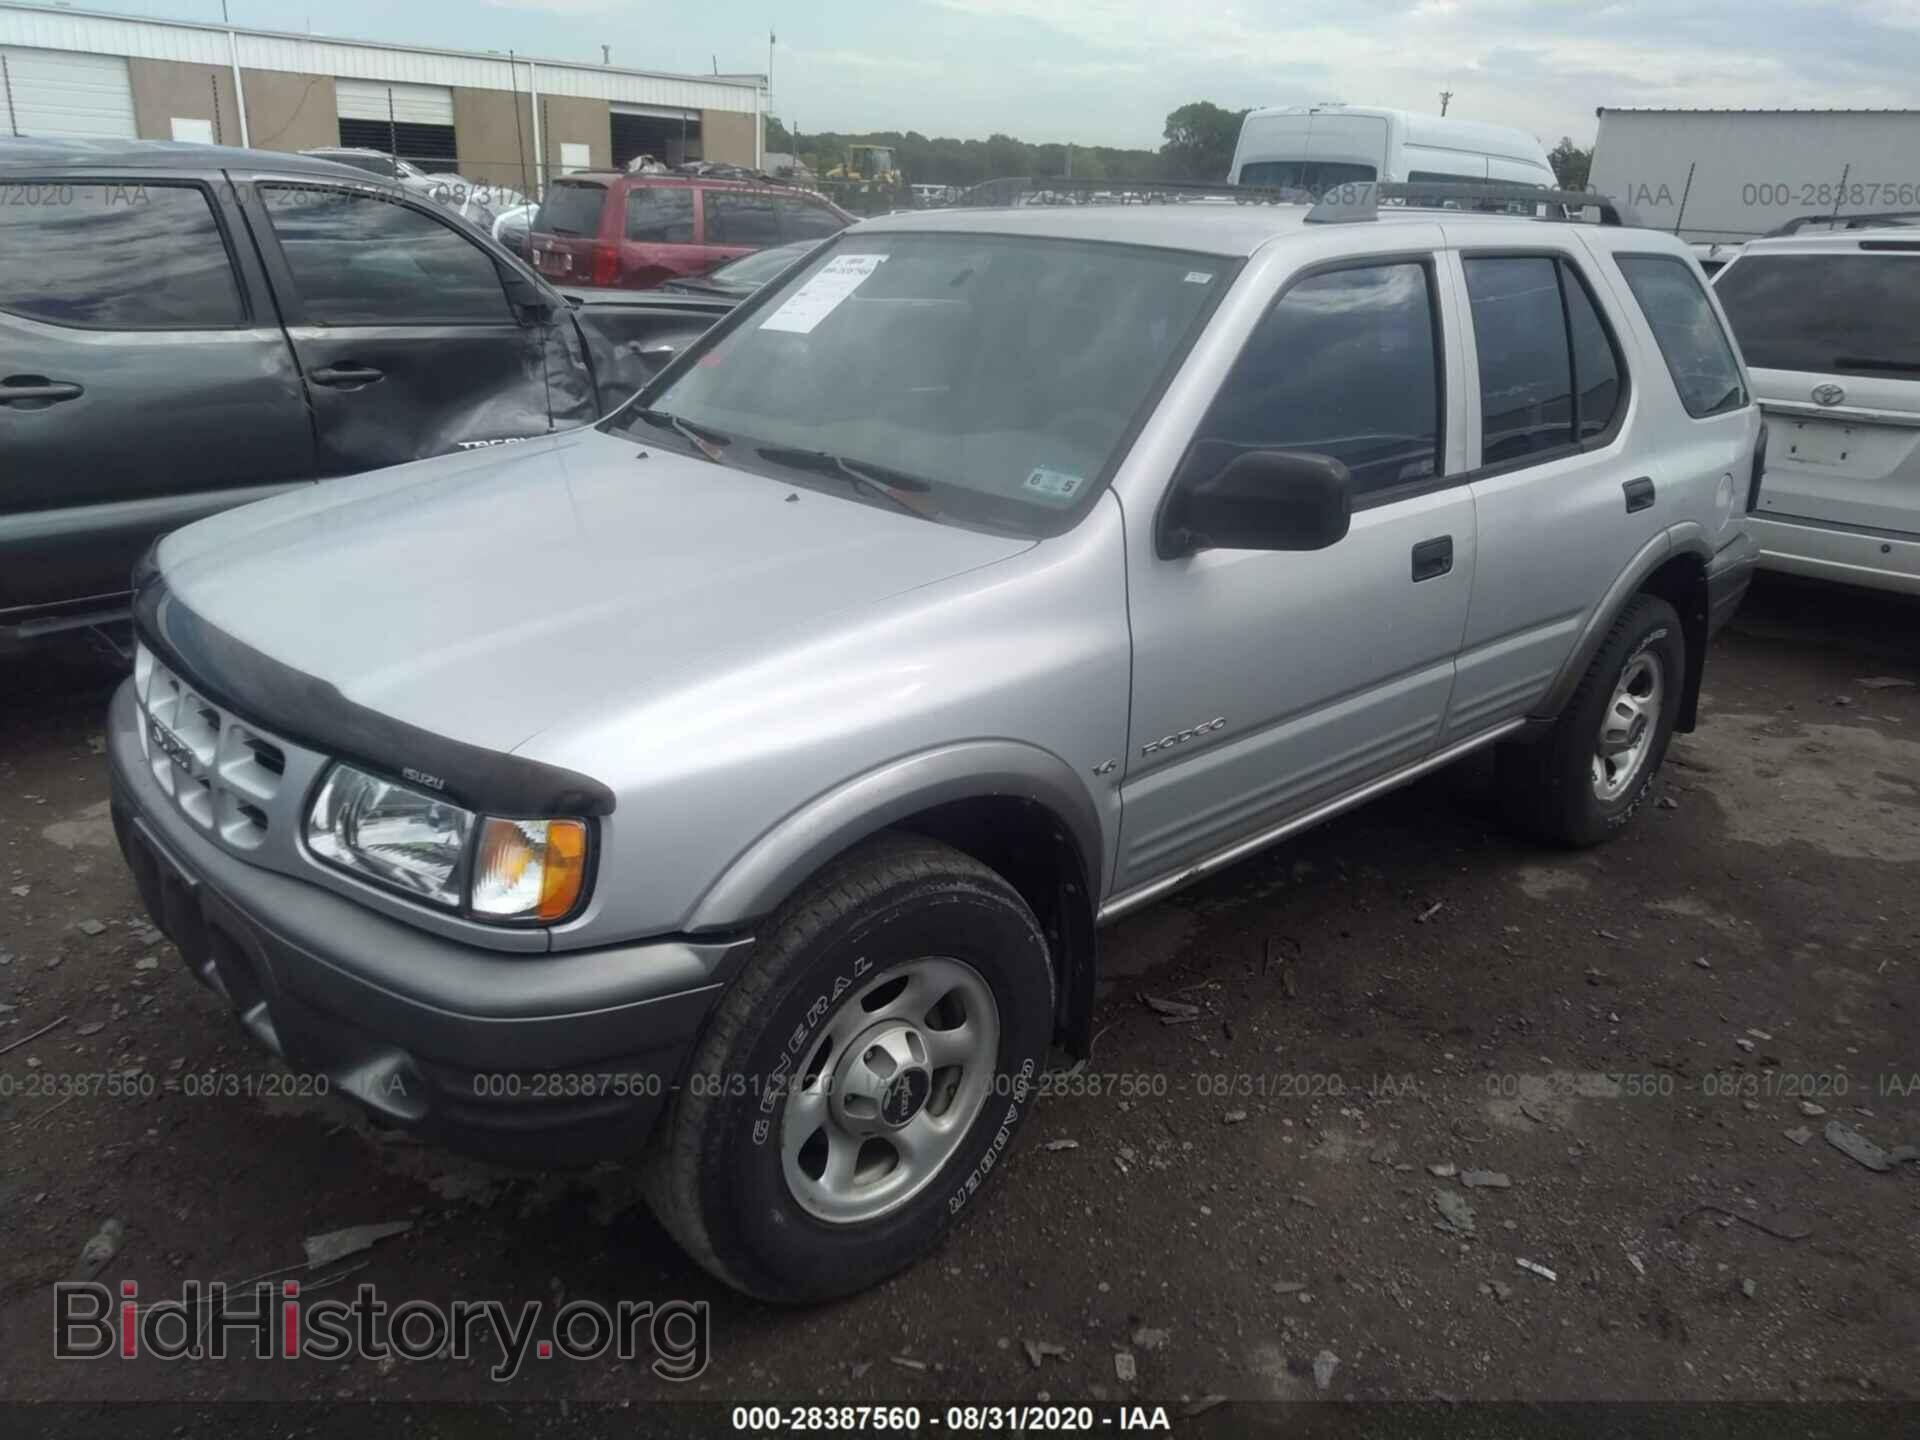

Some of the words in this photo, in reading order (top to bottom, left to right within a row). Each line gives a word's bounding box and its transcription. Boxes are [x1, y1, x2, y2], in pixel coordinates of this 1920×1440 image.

[402, 767, 445, 790] ISUZU
[1142, 716, 1226, 757] RODEO
[753, 956, 874, 1146] GENERAL
[949, 1058, 1035, 1215] GRABBER
